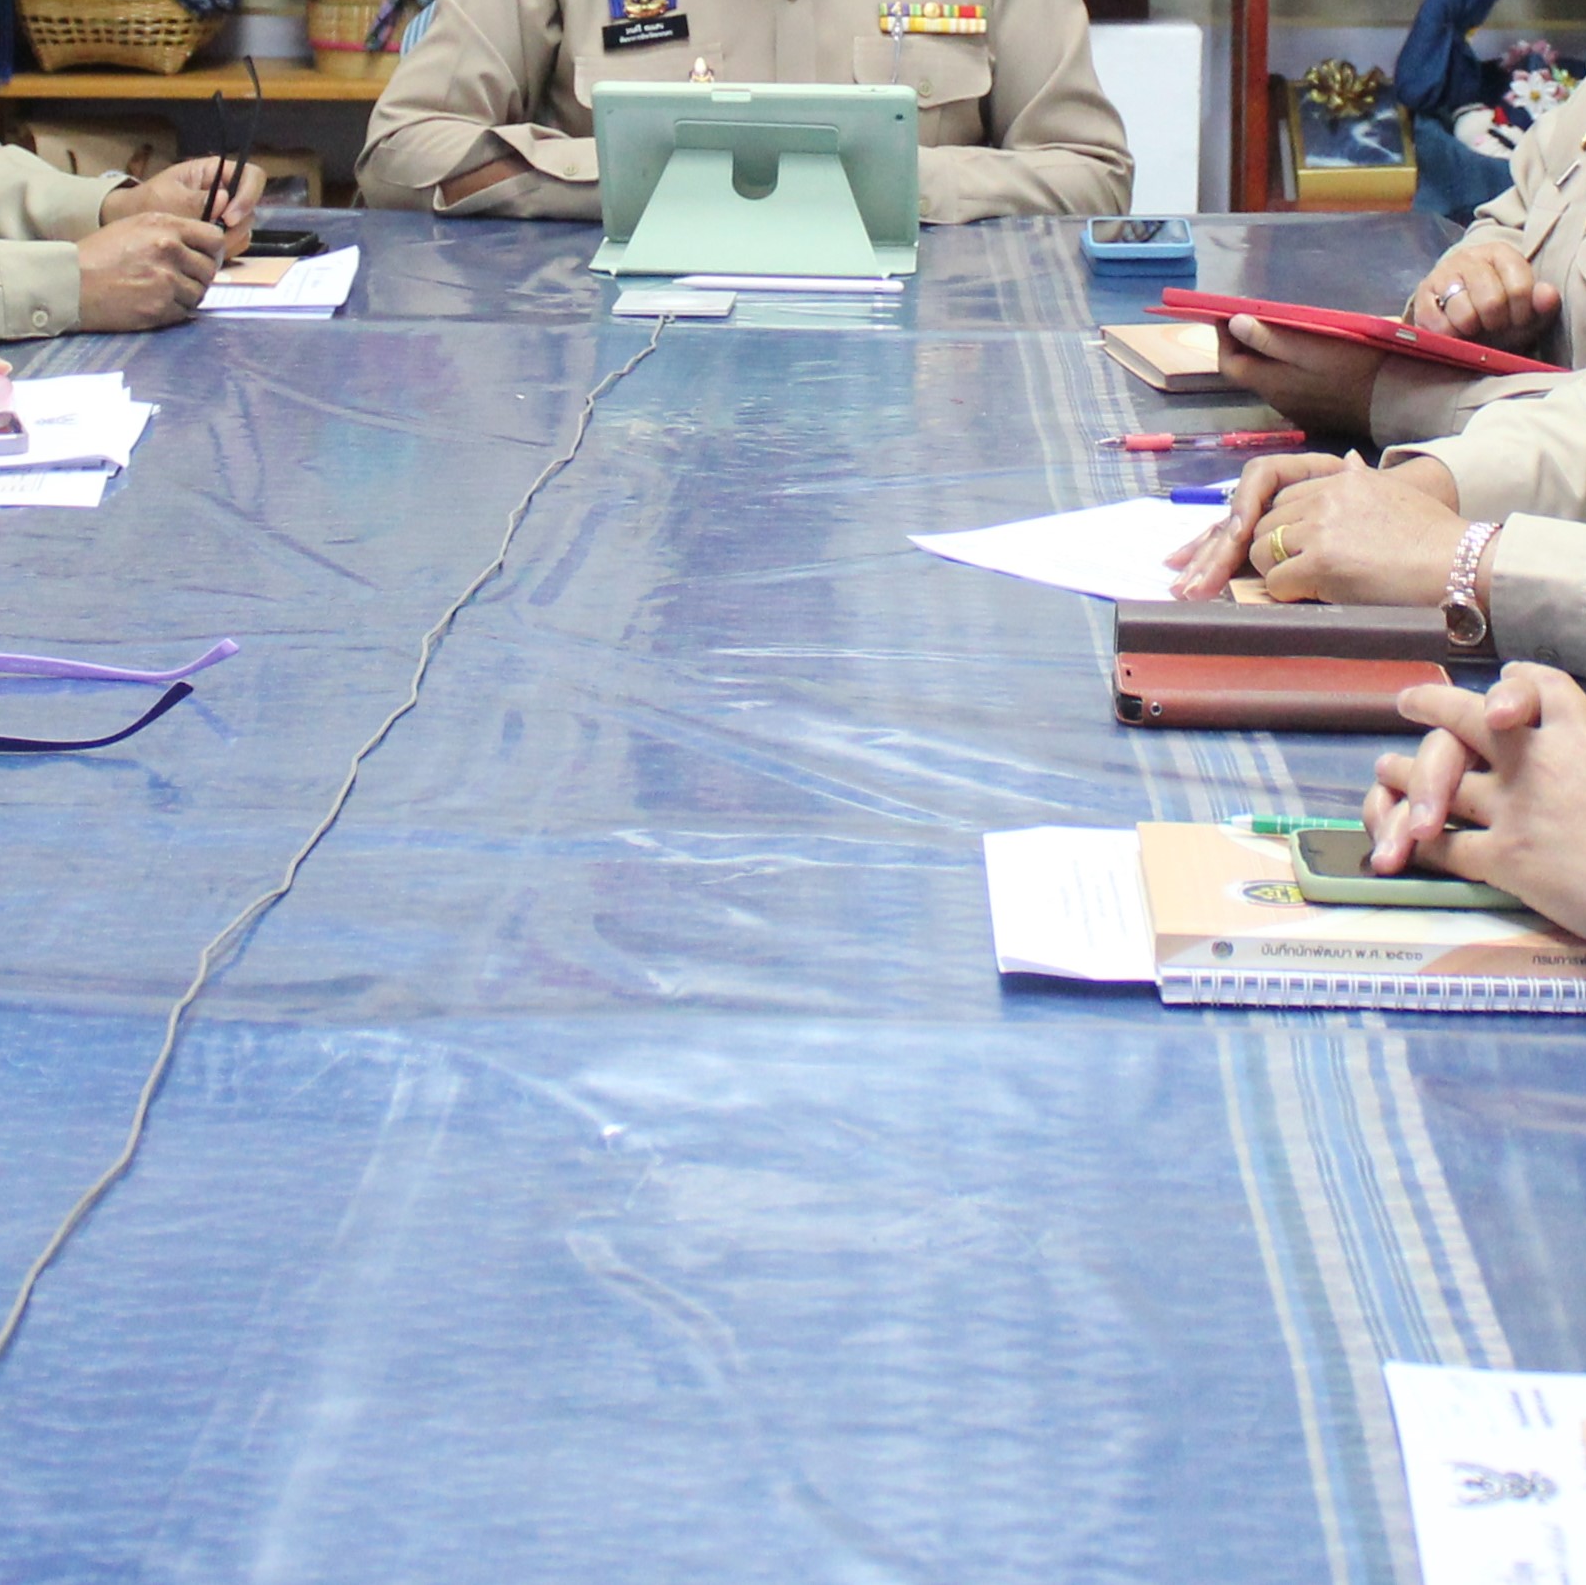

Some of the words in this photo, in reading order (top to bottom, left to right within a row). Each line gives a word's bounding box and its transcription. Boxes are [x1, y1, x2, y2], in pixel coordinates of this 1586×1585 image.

[1261, 943, 1352, 959] บันทึกนักพัฒนา
